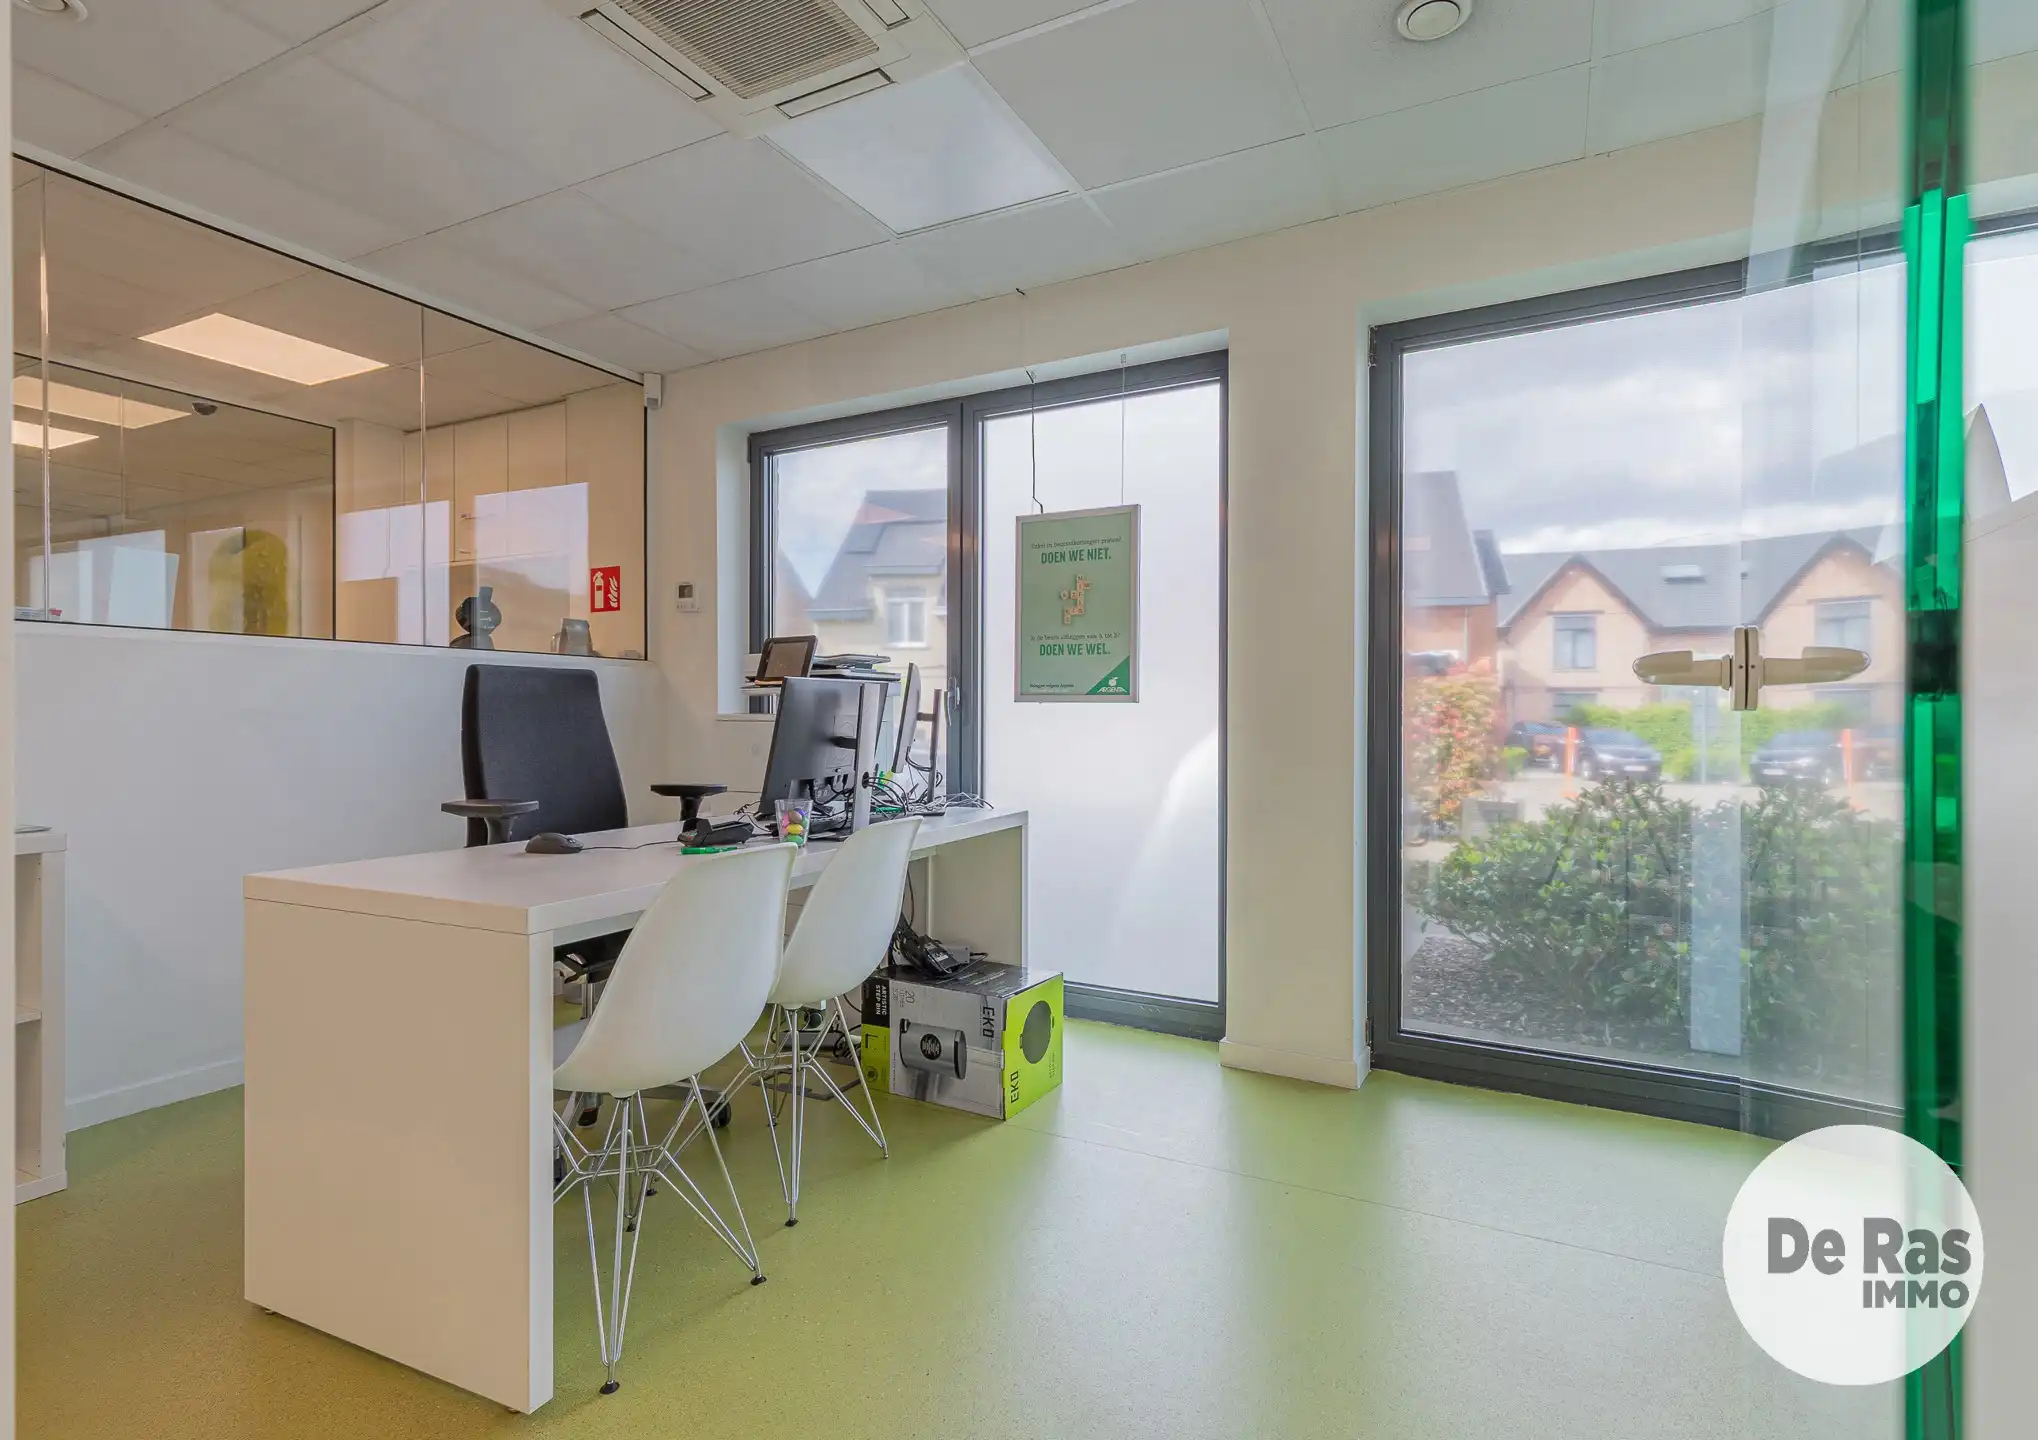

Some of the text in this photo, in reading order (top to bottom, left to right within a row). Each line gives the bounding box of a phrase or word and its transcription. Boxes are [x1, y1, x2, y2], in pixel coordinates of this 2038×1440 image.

[1041, 547, 1112, 564] DOEN WE NIET.
[1040, 642, 1111, 656] DOEN WE WEL.
[905, 989, 916, 1004] 20
[983, 1006, 995, 1038] EKO
[1010, 1070, 1019, 1104] EKO
